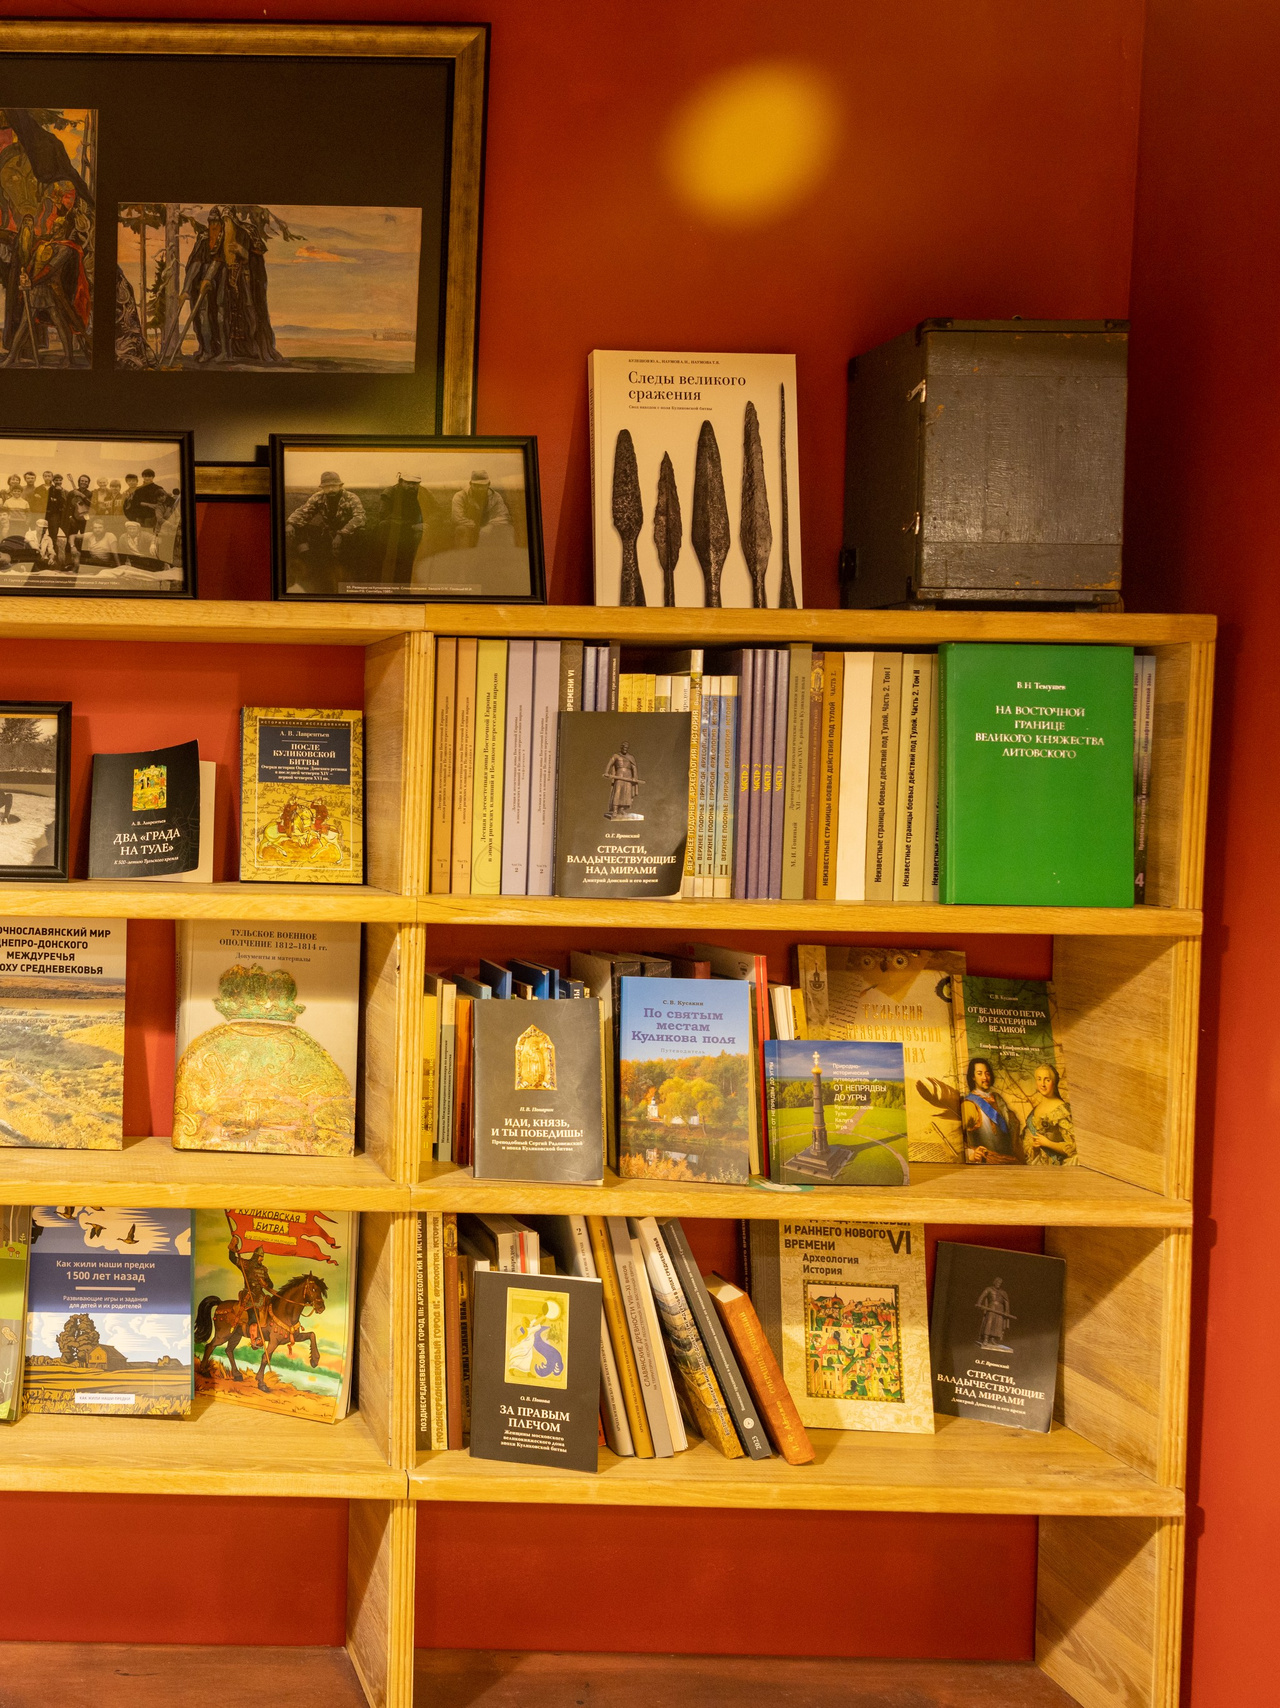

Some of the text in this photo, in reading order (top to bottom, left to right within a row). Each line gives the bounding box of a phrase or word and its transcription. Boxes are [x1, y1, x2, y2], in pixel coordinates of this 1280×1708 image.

[629, 371, 746, 386] Следы великого
[629, 389, 701, 402] сражения
[912, 676, 920, 687] Том
[1034, 682, 1066, 692] Темушев
[910, 697, 919, 716] Часть
[996, 705, 1085, 717] НА ВОСТОЧНОЙ
[1014, 720, 1065, 732] ГРАНИЦЕ
[975, 732, 1104, 746] ВЕЛИКОГО КНЯЖЕСТВА
[273, 750, 336, 758] КУЛИКОВСКОЙ
[1002, 748, 1076, 759] ЛИТОВСКОГО
[908, 754, 917, 784] действий
[741, 771, 749, 791] ЧАСТЬ
[686, 837, 694, 870] ВЕРХНЕЕ
[692, 710, 700, 744] ИСТОРИЯ
[907, 786, 915, 810] боевых
[904, 811, 914, 843] страницы
[113, 828, 180, 845] ДВА «ГРАДА
[120, 843, 174, 855] НА ТУЛЕ»
[597, 845, 647, 854] СТРАСТИ,
[567, 855, 676, 865] ВЛАДЫЧЕСТВУЮЩИЕ
[903, 845, 912, 887] Неизвестные
[586, 866, 657, 875] НАД МИРАМИ
[90, 930, 111, 938] МИР
[231, 929, 317, 940] ТУЛЬСКОЕ ВОЕННОЕ
[220, 939, 272, 948] ОПОЛЧЕНИЕ
[6, 951, 75, 961] МЕЖДУРЕЧЬЯ
[20, 964, 103, 974] СРЕДНЕВЕКОВЬЯ
[643, 1008, 723, 1020] По святым
[979, 1007, 1019, 1016] ВЕЛИКОГО
[1020, 1010, 1046, 1018] ПЕТРА
[656, 1022, 710, 1031] местам
[989, 1017, 1037, 1026] ЕКАТЕРИНЫ
[989, 1025, 1026, 1034] ВЕЛИКОЙ
[632, 1031, 736, 1044] Куликова поля
[834, 1094, 845, 1102] ДО
[505, 1118, 570, 1128] ИДИ, КНЯЗЬ,
[491, 1128, 583, 1139] И ТЫ ПОБЕДИШЬ!
[239, 1209, 300, 1223] КУЛИКОВСКАЯ
[256, 1222, 284, 1233] БИТВА
[784, 1225, 886, 1238] И РАННЕГО НОВОГО
[785, 1239, 835, 1250] ВРЕМЕНИ
[886, 1230, 911, 1254] VI
[803, 1253, 859, 1264] Археология
[124, 1262, 155, 1270] предки
[803, 1264, 842, 1275] История
[113, 1273, 145, 1283] назад
[967, 1369, 1016, 1385] СТРАСТИ,
[419, 1342, 427, 1431] ПОЗДНЕСРЕДНЕВЕКОВЫЙ
[937, 1374, 1045, 1399] ВЛАДЫЧЕСТВУЮЩИЕ
[955, 1387, 1024, 1406] НАД МИРАМИ
[500, 1405, 570, 1422] ЗА ПРАВЫМ
[508, 1418, 560, 1432] ПЛЕЧОМ
[751, 1435, 762, 1450] 2023
